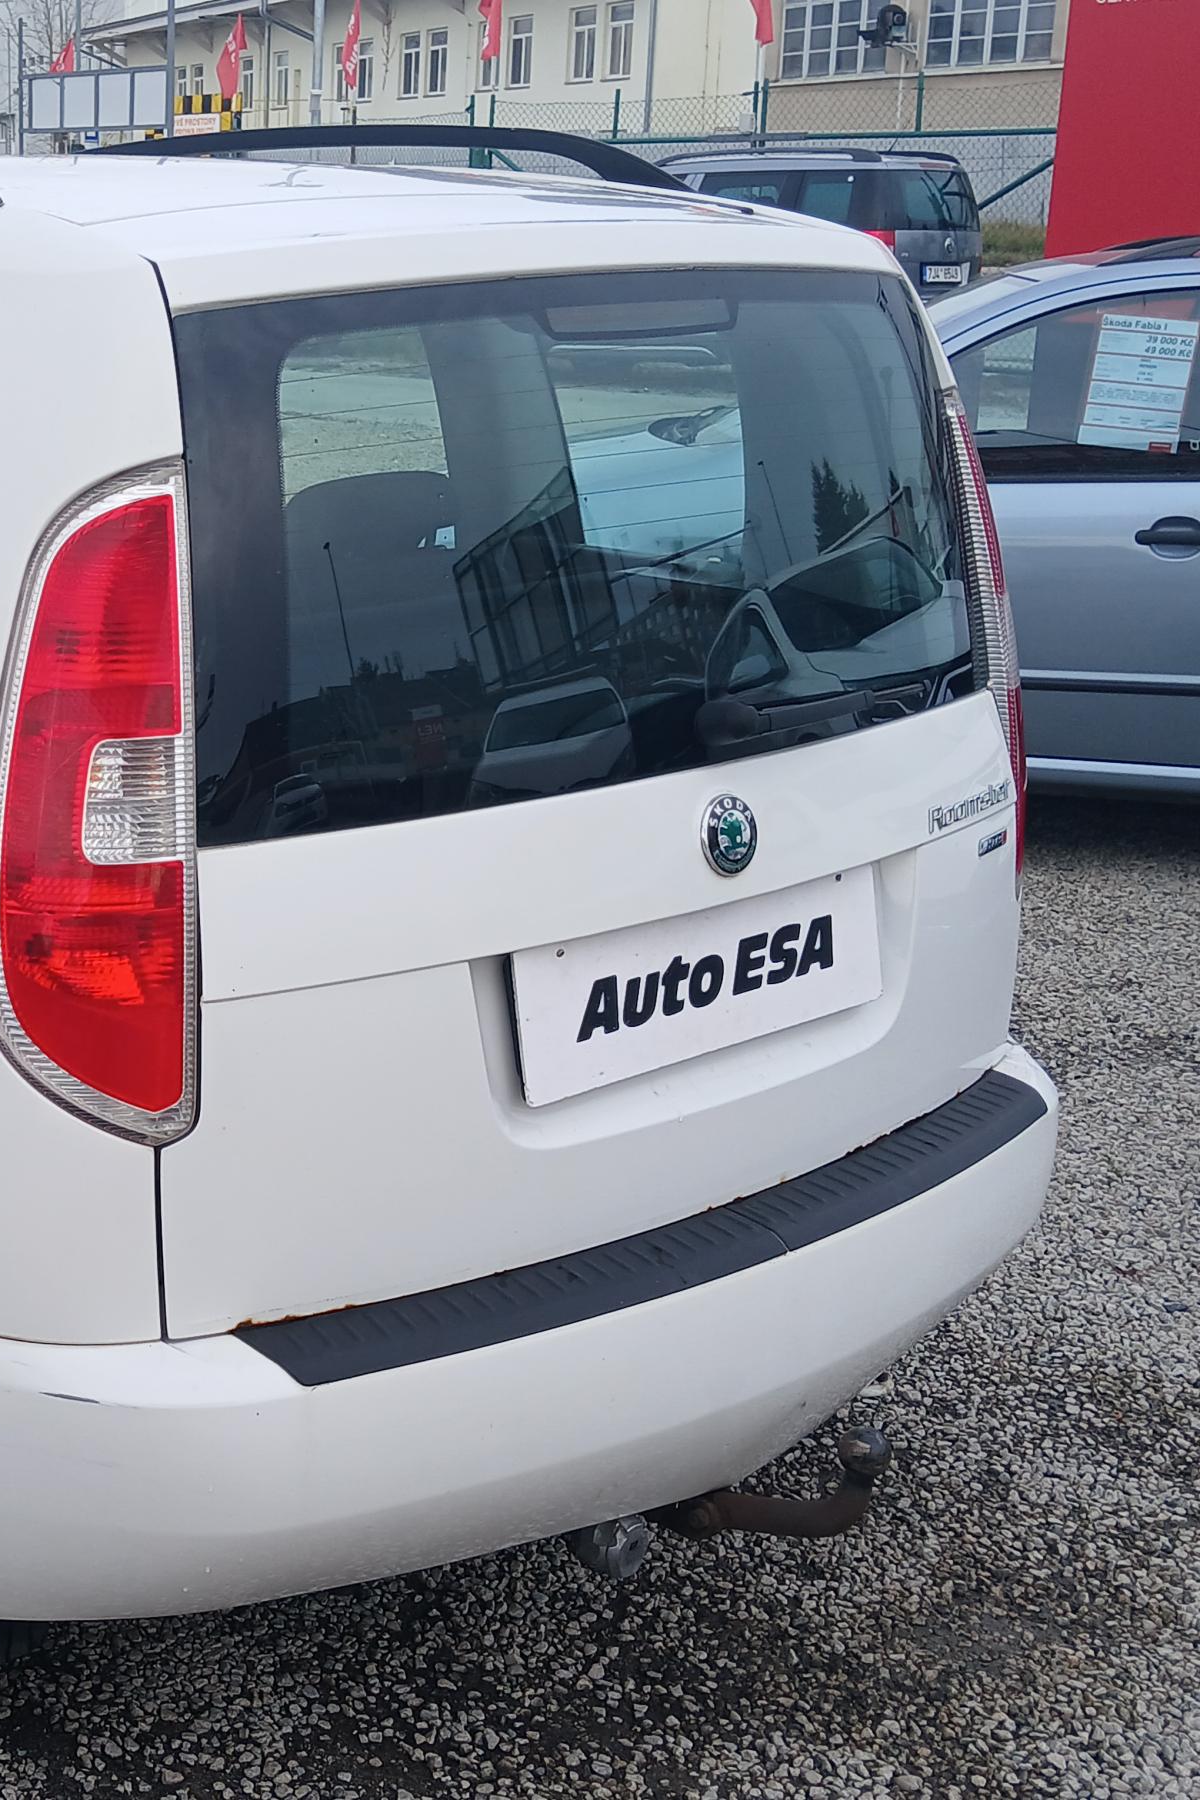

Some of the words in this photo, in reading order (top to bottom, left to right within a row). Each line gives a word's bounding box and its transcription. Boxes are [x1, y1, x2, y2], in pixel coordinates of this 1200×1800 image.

[1103, 316, 1132, 329] Škoda
[1135, 320, 1161, 331] Fabia
[1146, 335, 1158, 344] 39
[1160, 336, 1178, 346] 000
[1145, 346, 1156, 354] 49
[1158, 347, 1176, 357] 000
[576, 955, 724, 1043] Auto
[732, 914, 834, 996] ESA
